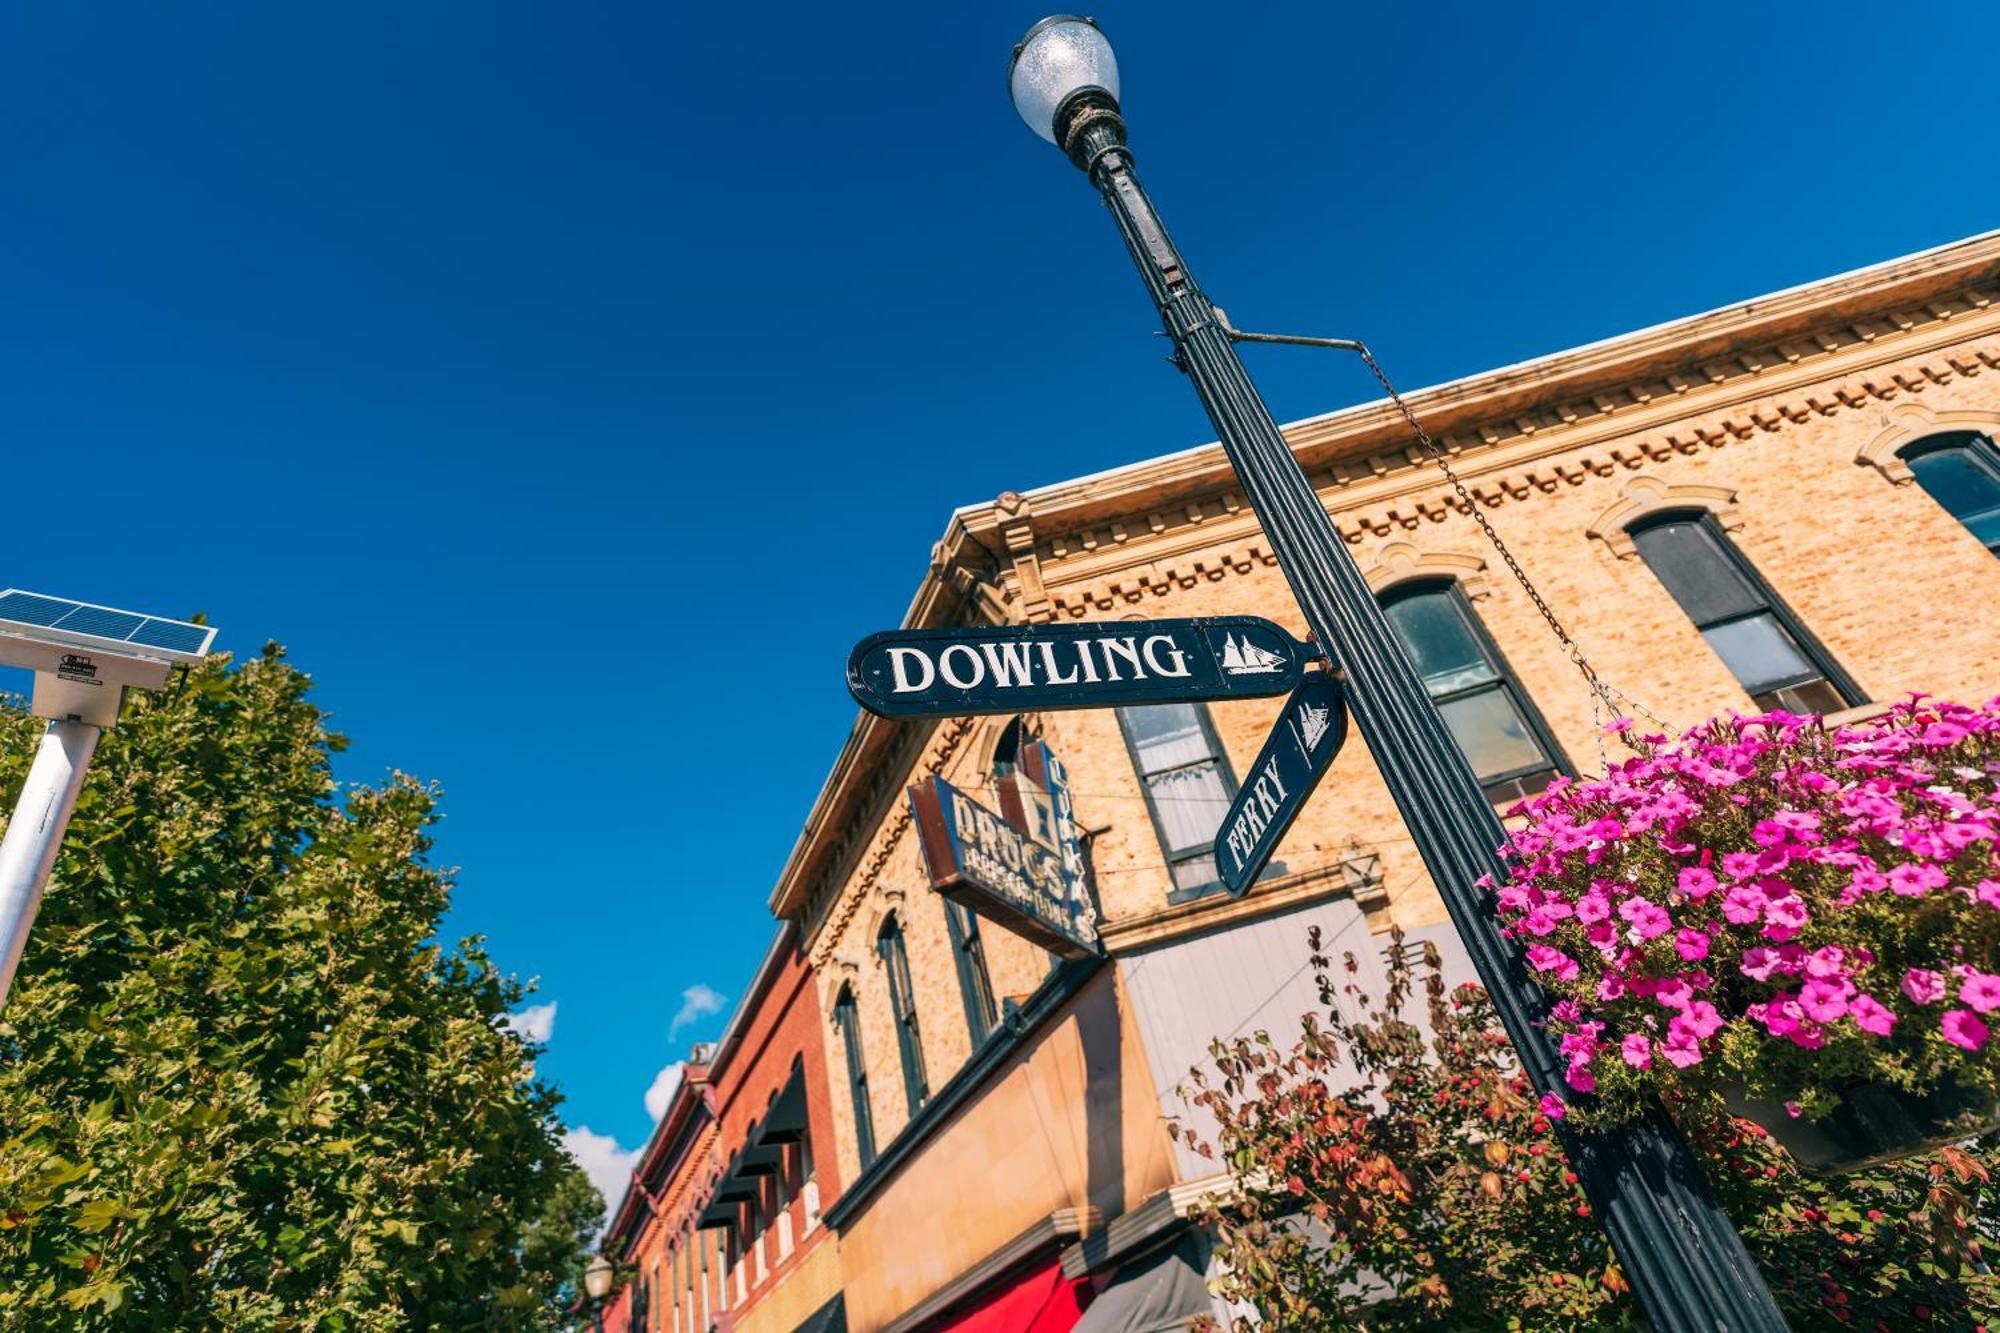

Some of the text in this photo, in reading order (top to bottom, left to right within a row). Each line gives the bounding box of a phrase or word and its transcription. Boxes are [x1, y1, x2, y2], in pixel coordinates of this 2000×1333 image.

[885, 634, 1192, 694] DOWLING
[952, 793, 1067, 901] DRUGS
[1226, 754, 1289, 873] FERRY
